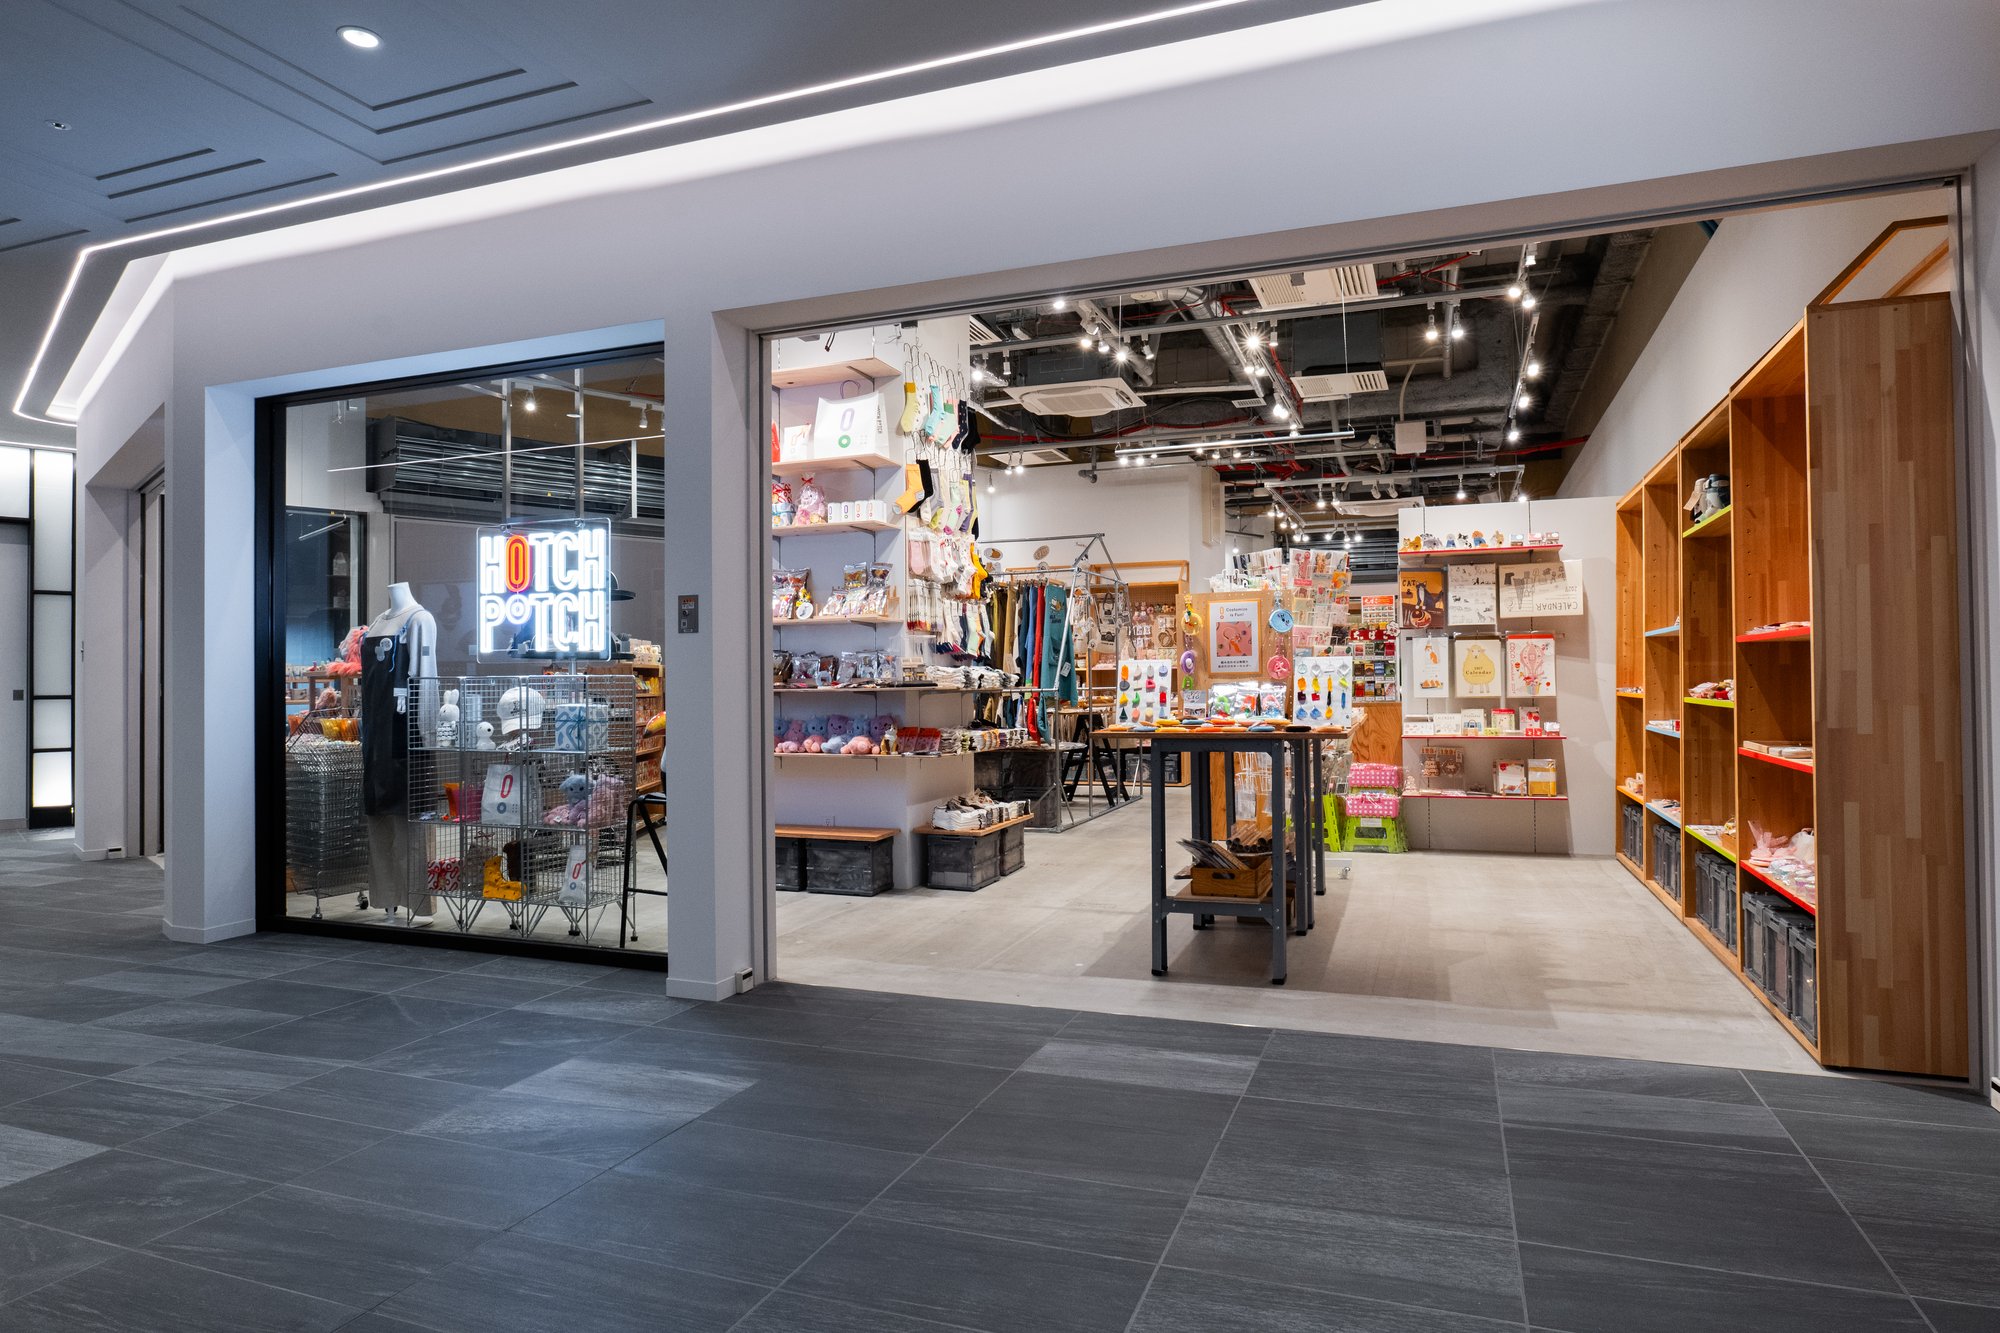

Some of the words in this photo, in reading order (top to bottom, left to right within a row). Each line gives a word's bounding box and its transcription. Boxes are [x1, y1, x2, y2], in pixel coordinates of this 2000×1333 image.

[480, 528, 606, 594] HOTCH
[480, 591, 606, 653] POTCH
[1536, 601, 1579, 611] CALENDAR
